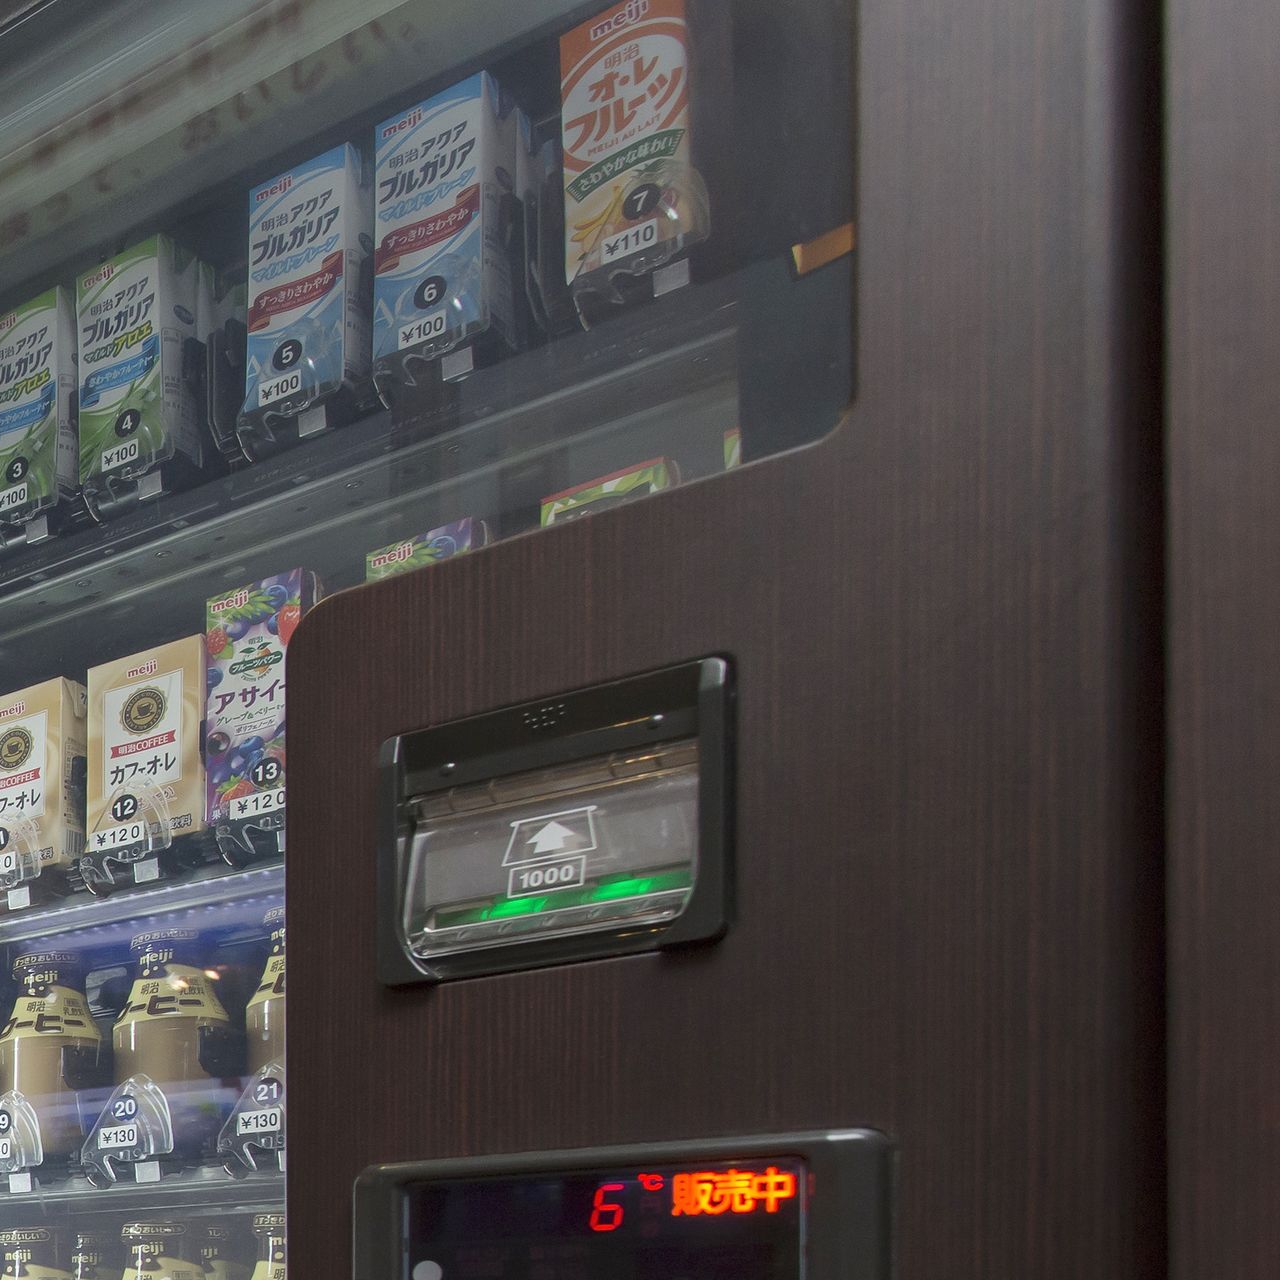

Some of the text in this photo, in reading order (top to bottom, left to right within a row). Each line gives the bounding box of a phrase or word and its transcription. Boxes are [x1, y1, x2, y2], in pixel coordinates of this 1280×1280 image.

[590, 0, 649, 41] meiji
[603, 46, 640, 70] 明治
[588, 56, 659, 102] オ・レ
[565, 66, 683, 154] フルーツ
[383, 109, 422, 138] meiji
[389, 120, 468, 170] 明治アクア
[379, 136, 476, 205] ブルガリア
[255, 175, 292, 201] meiji
[261, 188, 333, 232] 明治アクア
[635, 191, 649, 212] 7
[253, 205, 339, 266] ブルガリア
[386, 208, 469, 248] すっきりさわやか
[605, 225, 654, 256] ¥110
[83, 263, 115, 288] meiji
[90, 276, 149, 316] 明治アクア
[260, 273, 333, 308] すっきりさわやか
[424, 285, 438, 303] 6
[83, 293, 155, 348] ブルガリア
[402, 316, 443, 345] ¥100
[260, 375, 300, 401] ¥100
[103, 443, 137, 466] ¥100
[370, 542, 415, 569] meiji
[211, 591, 250, 612] meiji
[127, 660, 159, 678] meiji
[118, 734, 170, 757] 明治COFFEE
[255, 764, 277, 782] 13
[114, 799, 135, 816] 12
[96, 825, 140, 847] ¥120
[520, 863, 576, 889] 1000
[140, 949, 173, 966] meiji
[24, 970, 58, 986] meiji
[256, 1083, 279, 1101] 21
[115, 1101, 137, 1117] 20
[241, 1114, 278, 1130] ¥130
[103, 1129, 135, 1144] ¥130
[671, 1167, 797, 1216] 販売中
[131, 1242, 164, 1256] meiji
